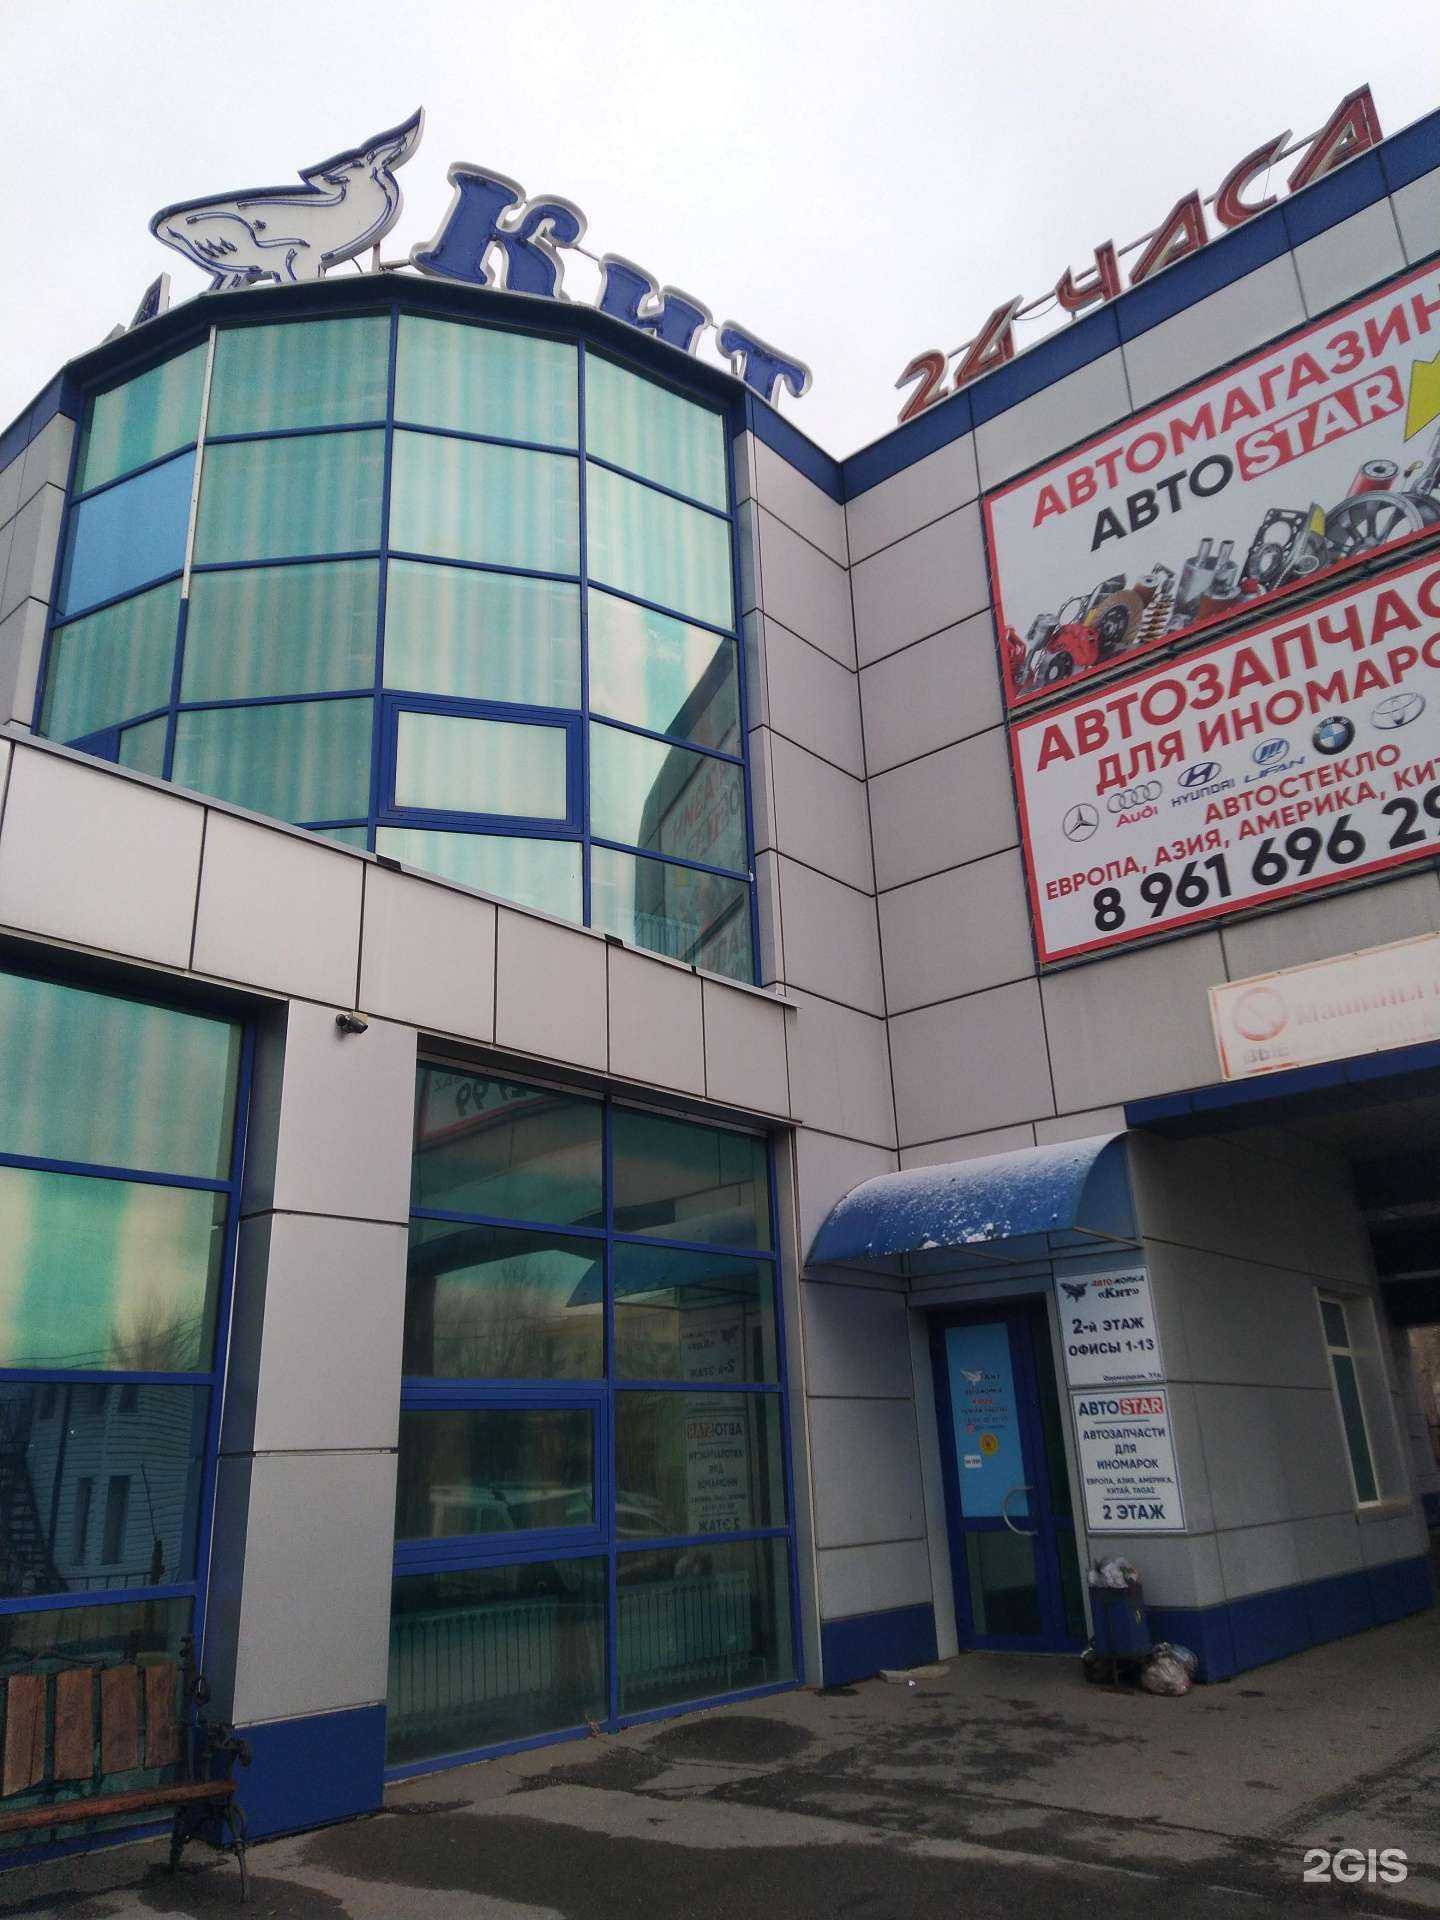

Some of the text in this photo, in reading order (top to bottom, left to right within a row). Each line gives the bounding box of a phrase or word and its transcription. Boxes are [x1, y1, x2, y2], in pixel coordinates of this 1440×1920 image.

[896, 83, 1383, 423] 24 ЧАСА
[1032, 283, 1440, 528] АВТОМАГАЗИН
[1096, 730, 1186, 796] ДЛЯ
[1244, 755, 1306, 783] LIFAN
[1171, 779, 1236, 808] HYUNDAI
[1204, 744, 1402, 825] АВТОСТЕКЛО
[1116, 806, 1159, 828] Audi
[1046, 855, 1147, 900] ЕВРОПА,
[1154, 829, 1230, 867] АЗИЯ,
[1238, 781, 1388, 841] АМЕРИКА,
[1093, 887, 1126, 932] 8
[1140, 852, 1232, 918] 961
[1252, 814, 1365, 886] 696
[1072, 1316, 1144, 1334] 2-й ЭТАЖ
[1068, 1338, 1154, 1356] ОФИСЫ 1-13
[1083, 1427, 1166, 1441] АВТОЗАПЧАСТИ
[1115, 1443, 1137, 1455] ДЛЯ
[1097, 1458, 1160, 1470] ИНОМАРОК
[1103, 1504, 1166, 1520] 2 ЭТАЖ
